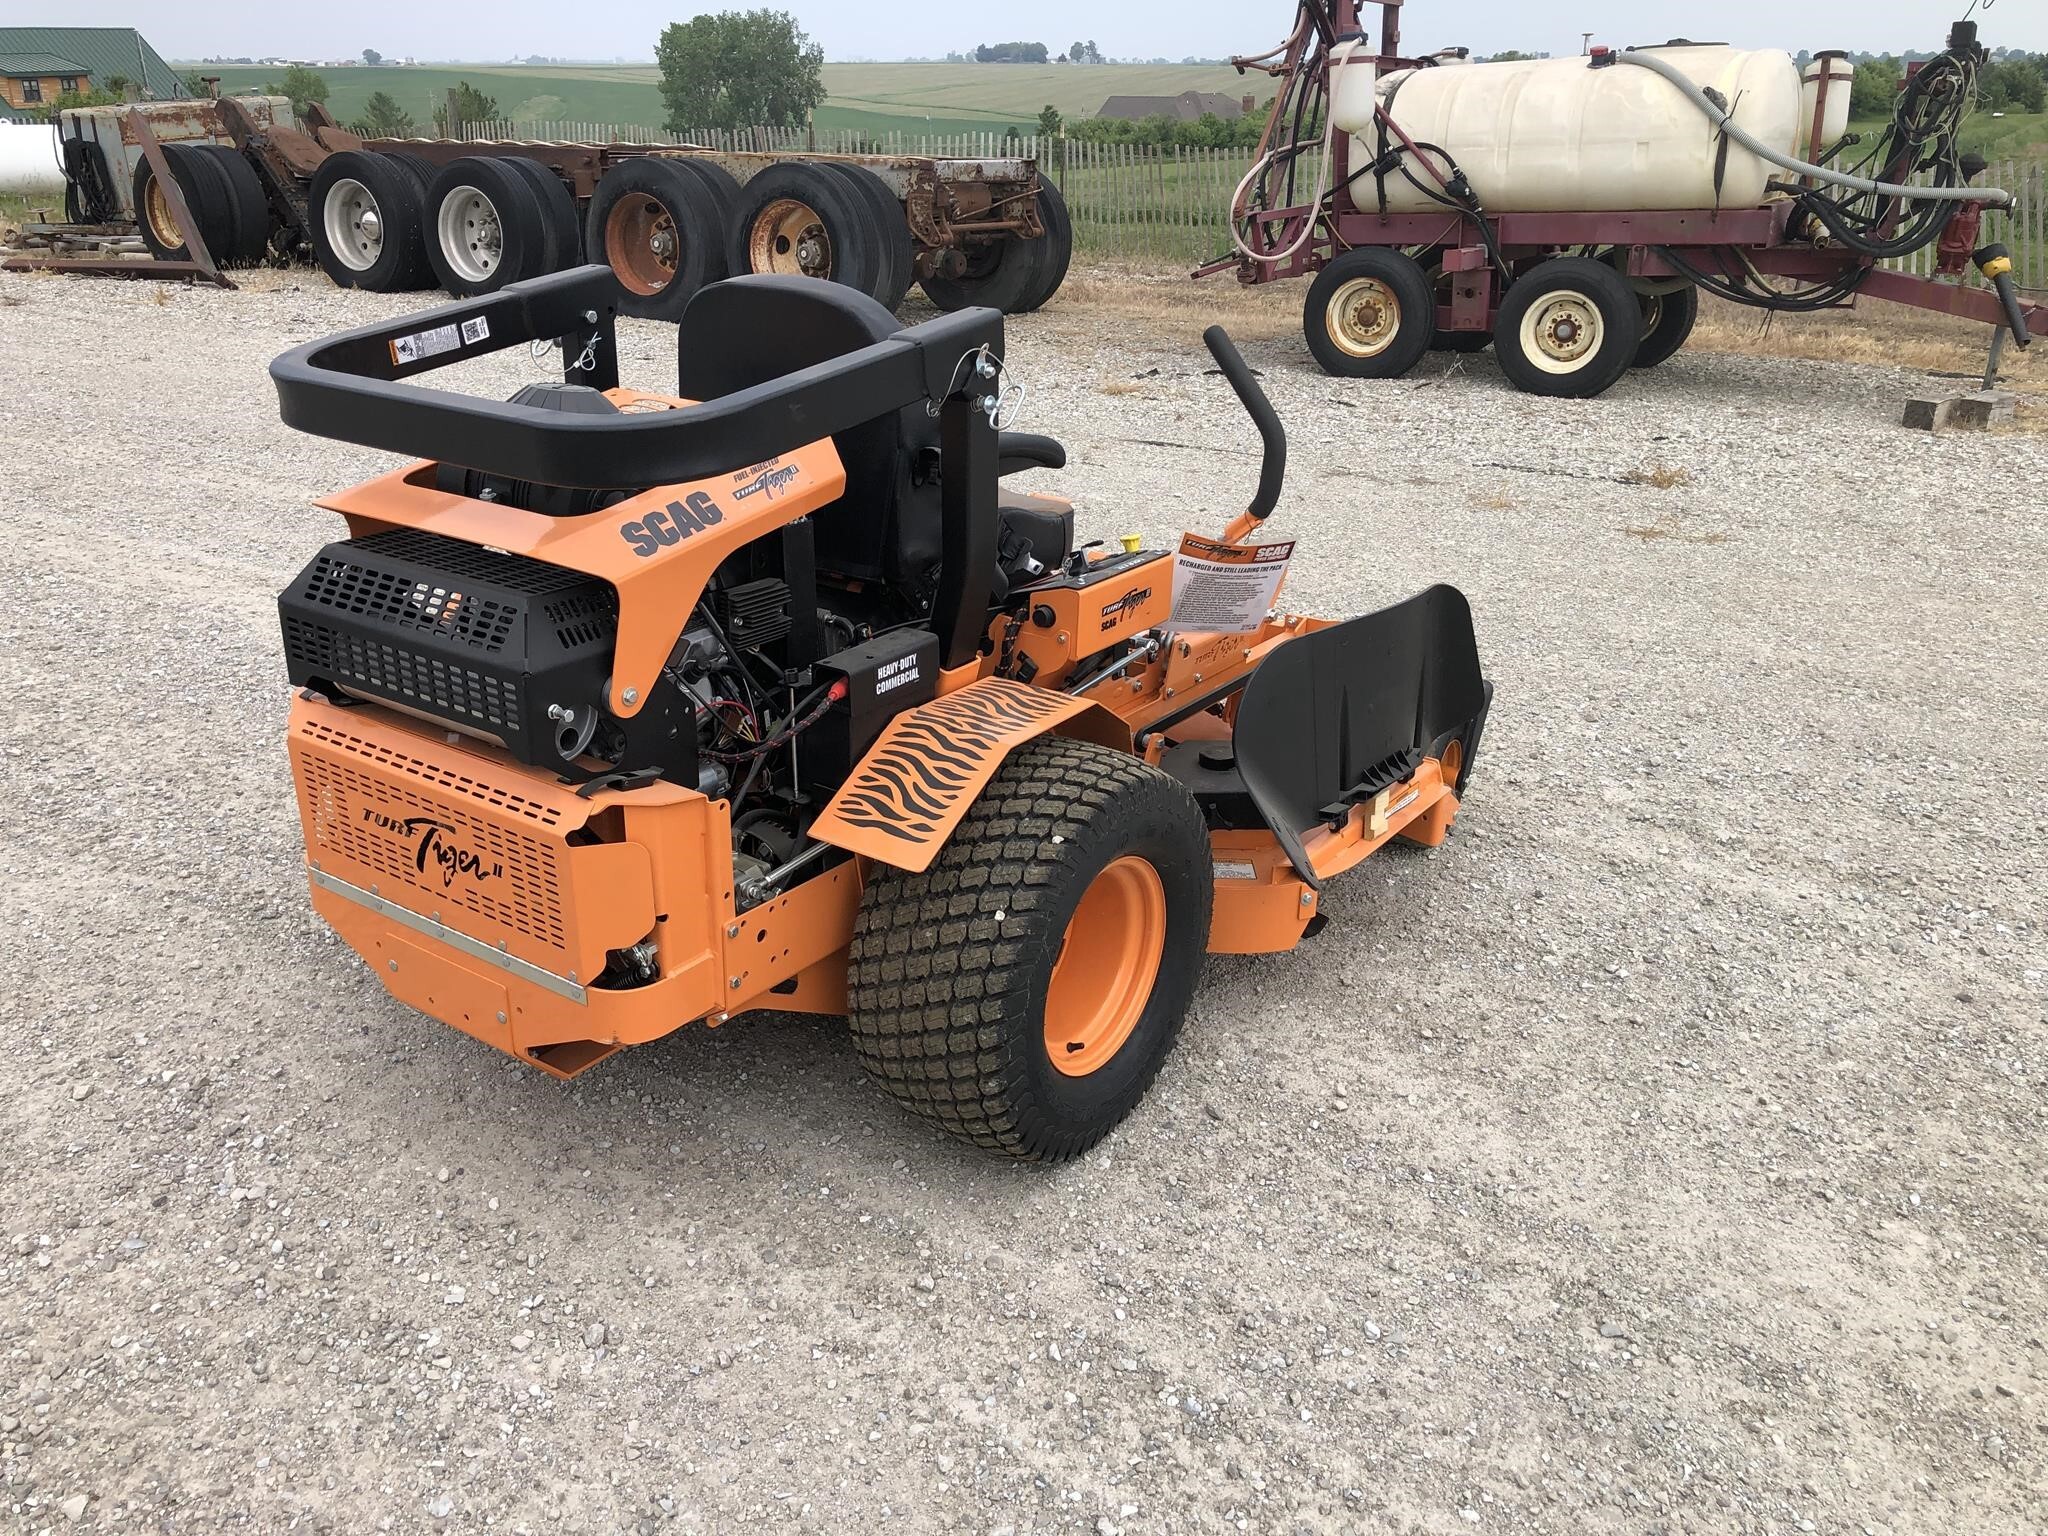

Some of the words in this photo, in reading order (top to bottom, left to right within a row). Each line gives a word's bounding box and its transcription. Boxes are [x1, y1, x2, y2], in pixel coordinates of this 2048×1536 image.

[733, 457, 780, 483] FUEL-INJECTED
[735, 481, 763, 499] TURF
[620, 491, 723, 557] SCAG
[1186, 540, 1212, 552] TURF
[1256, 545, 1290, 558] SCAG
[1178, 559, 1211, 572] RECHARGED
[1211, 565, 1224, 573] AND
[1237, 565, 1260, 573] LEADING
[1260, 564, 1270, 572] THE
[1269, 563, 1283, 571] PACK
[1103, 600, 1125, 615] TURF
[1101, 617, 1117, 632] SCAG
[878, 653, 917, 680] HEAVY-DUTY
[876, 667, 919, 695] COMMERCIAL
[363, 808, 419, 838] TURF
[404, 818, 490, 888] Tiger
